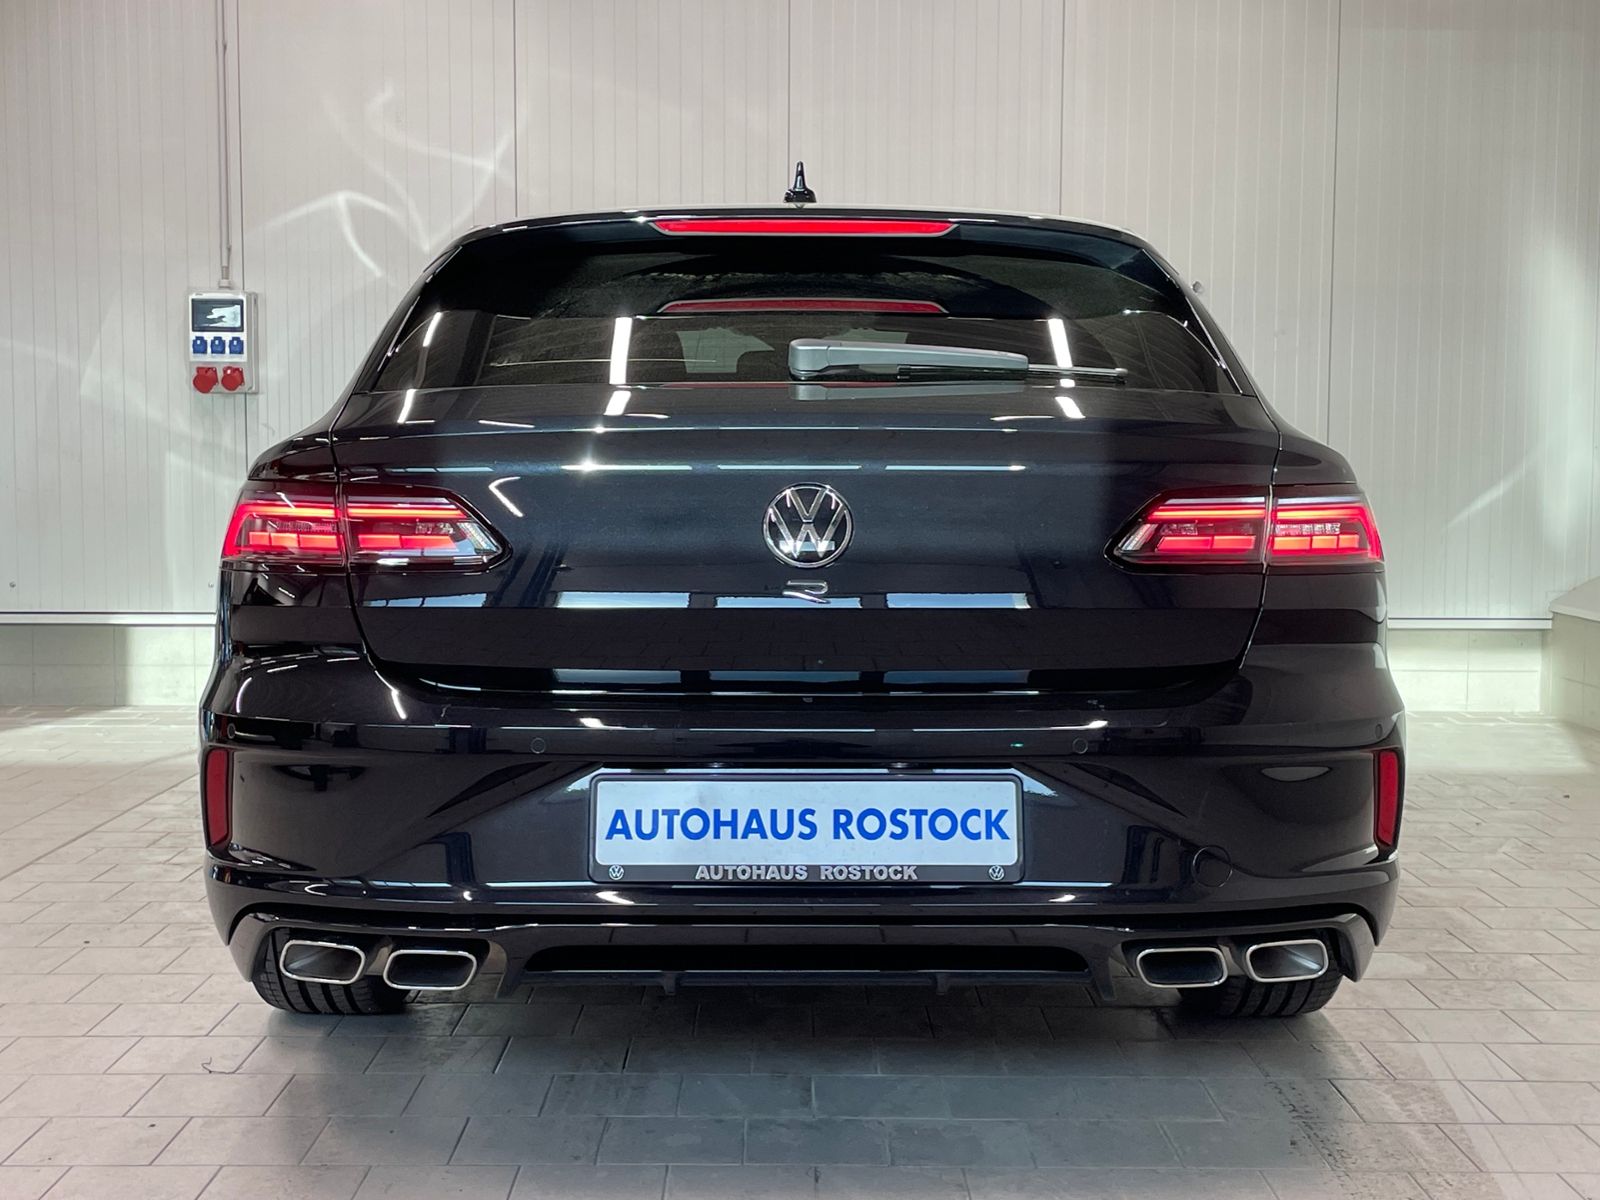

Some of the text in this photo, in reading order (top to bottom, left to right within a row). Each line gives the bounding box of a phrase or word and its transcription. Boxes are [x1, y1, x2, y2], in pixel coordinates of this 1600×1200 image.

[605, 807, 1011, 841] AUTOHAUS ROSTOCK
[695, 864, 918, 881] AUTOHAUS ROSTOCK
